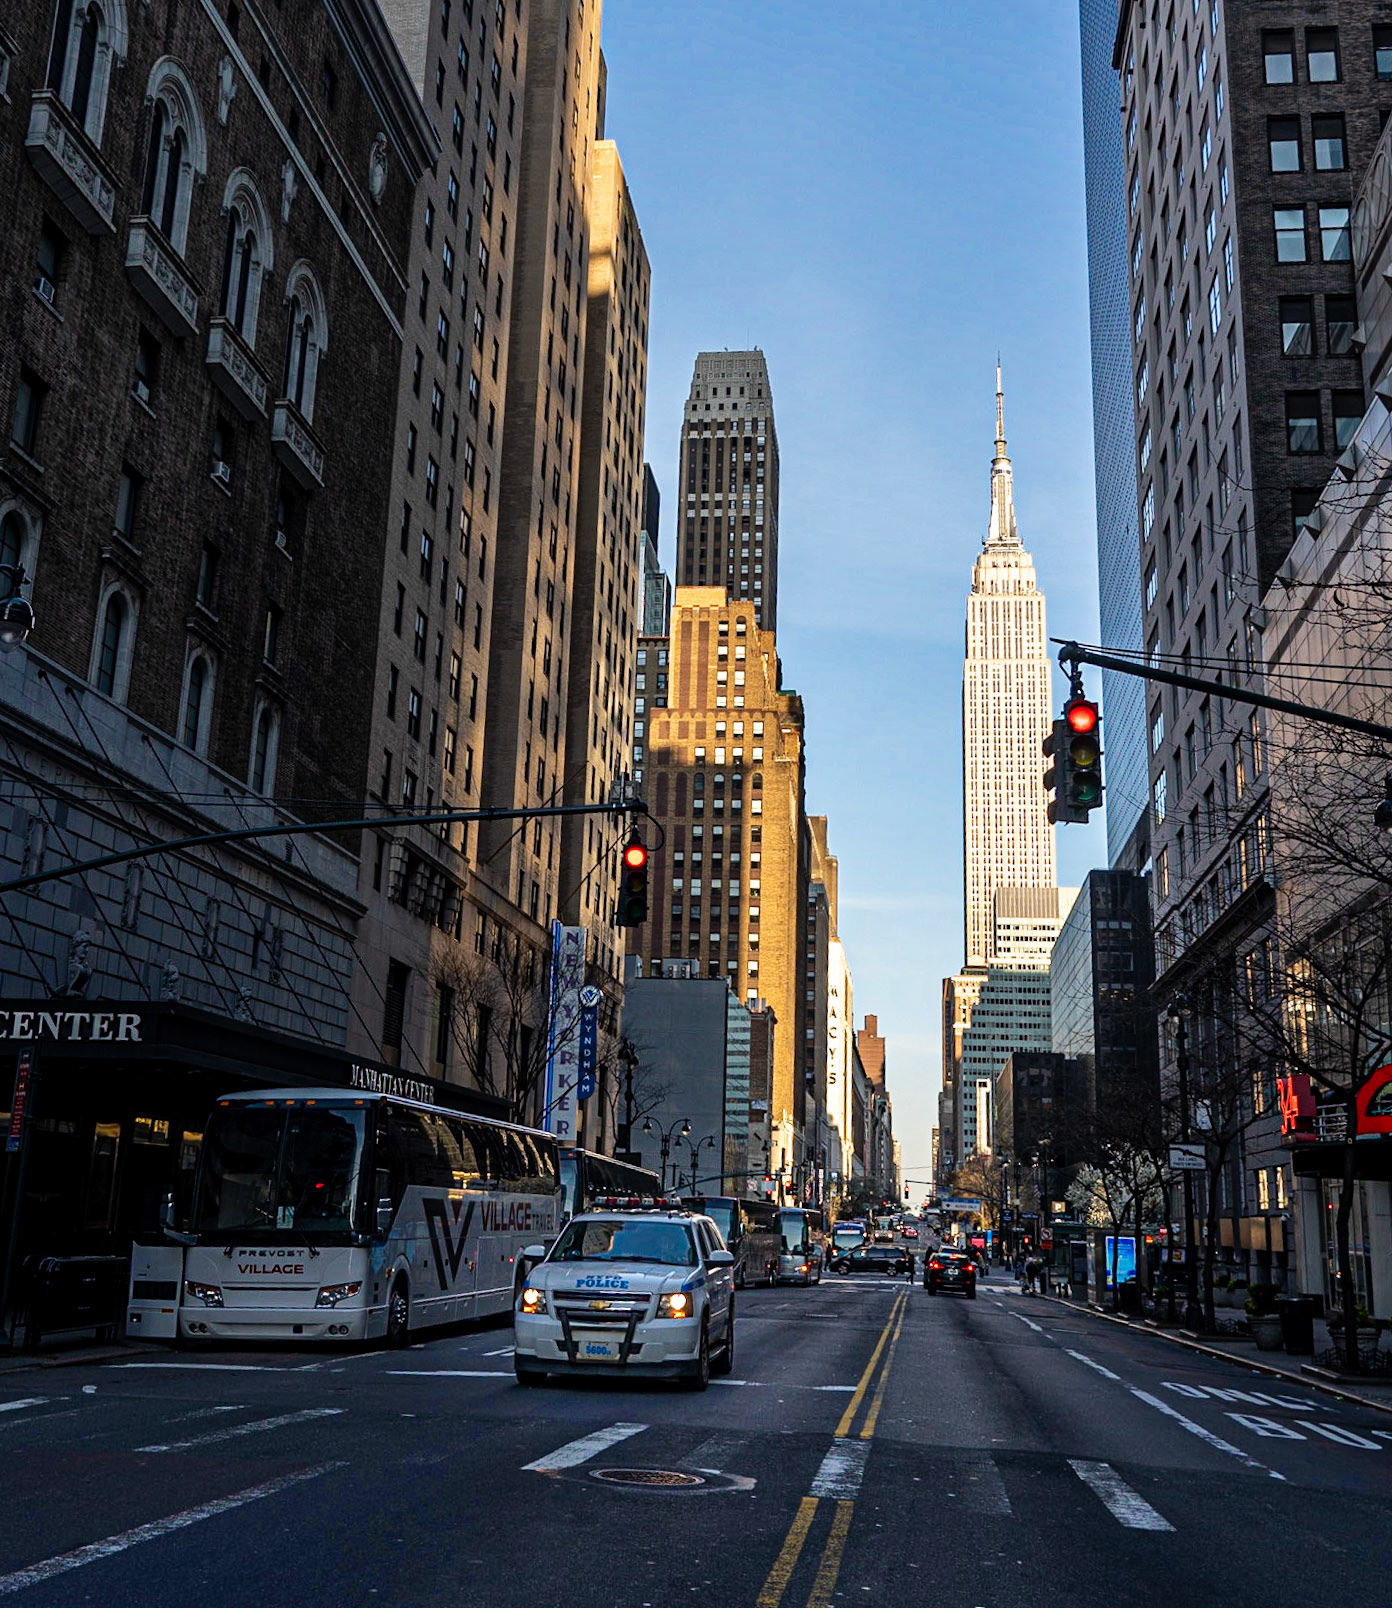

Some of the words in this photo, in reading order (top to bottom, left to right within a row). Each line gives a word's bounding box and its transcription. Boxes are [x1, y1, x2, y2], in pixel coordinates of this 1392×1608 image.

[580, 1011, 594, 1094] WYNDHAM
[350, 1063, 404, 1096] MANHATTAN
[404, 1079, 434, 1105] CENTER
[480, 1200, 532, 1232] VILLAGE
[237, 1263, 305, 1275] VILLAGE
[575, 1279, 630, 1290] POLICE
[1223, 1411, 1392, 1450] BU
